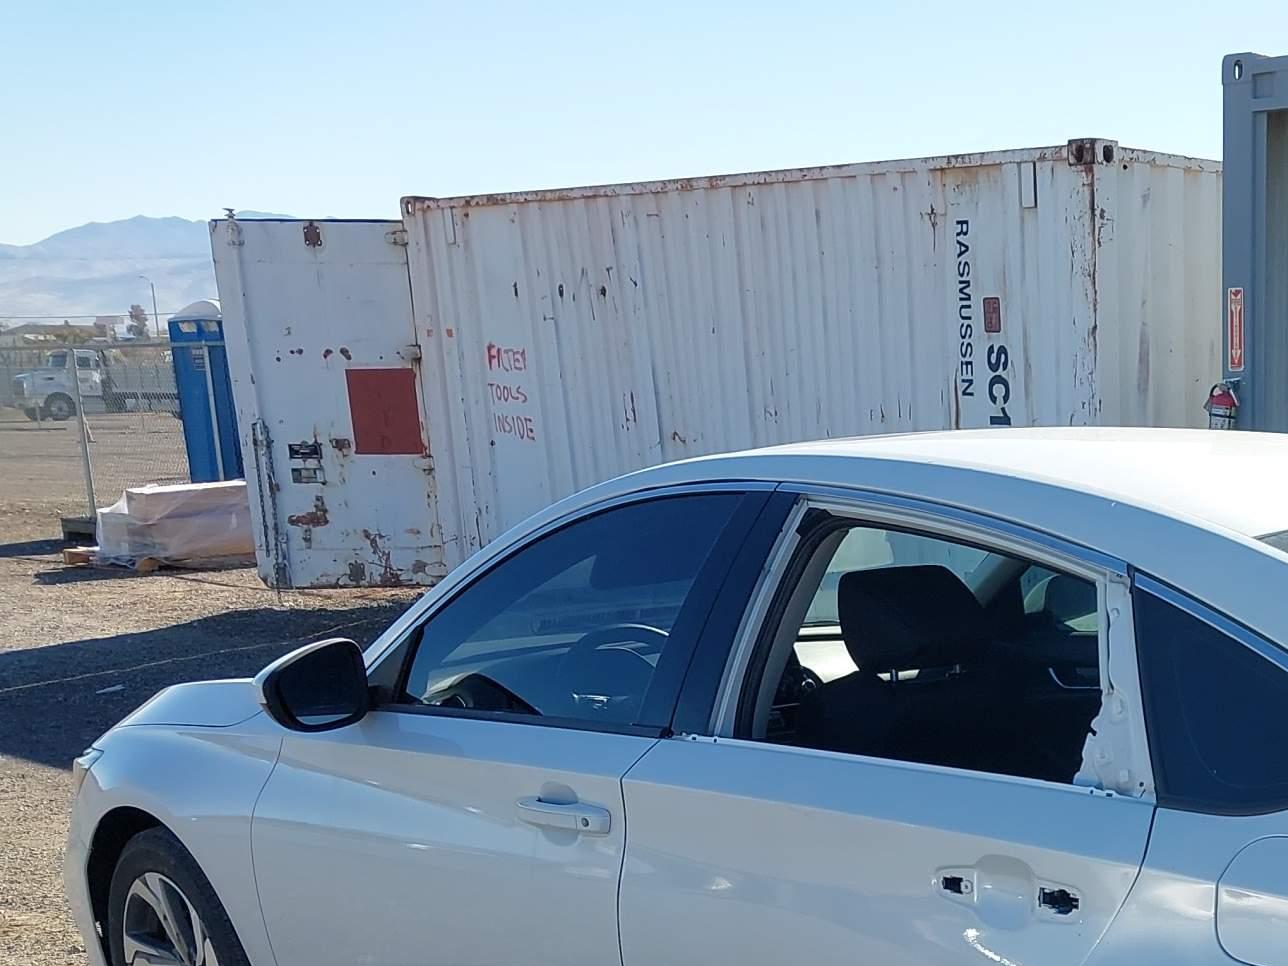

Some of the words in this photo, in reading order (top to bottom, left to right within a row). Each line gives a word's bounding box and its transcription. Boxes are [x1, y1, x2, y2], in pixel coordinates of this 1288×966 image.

[956, 219, 975, 397] RASMUSSEN
[488, 382, 528, 405] TOOLS
[494, 412, 536, 441] INSIDE
